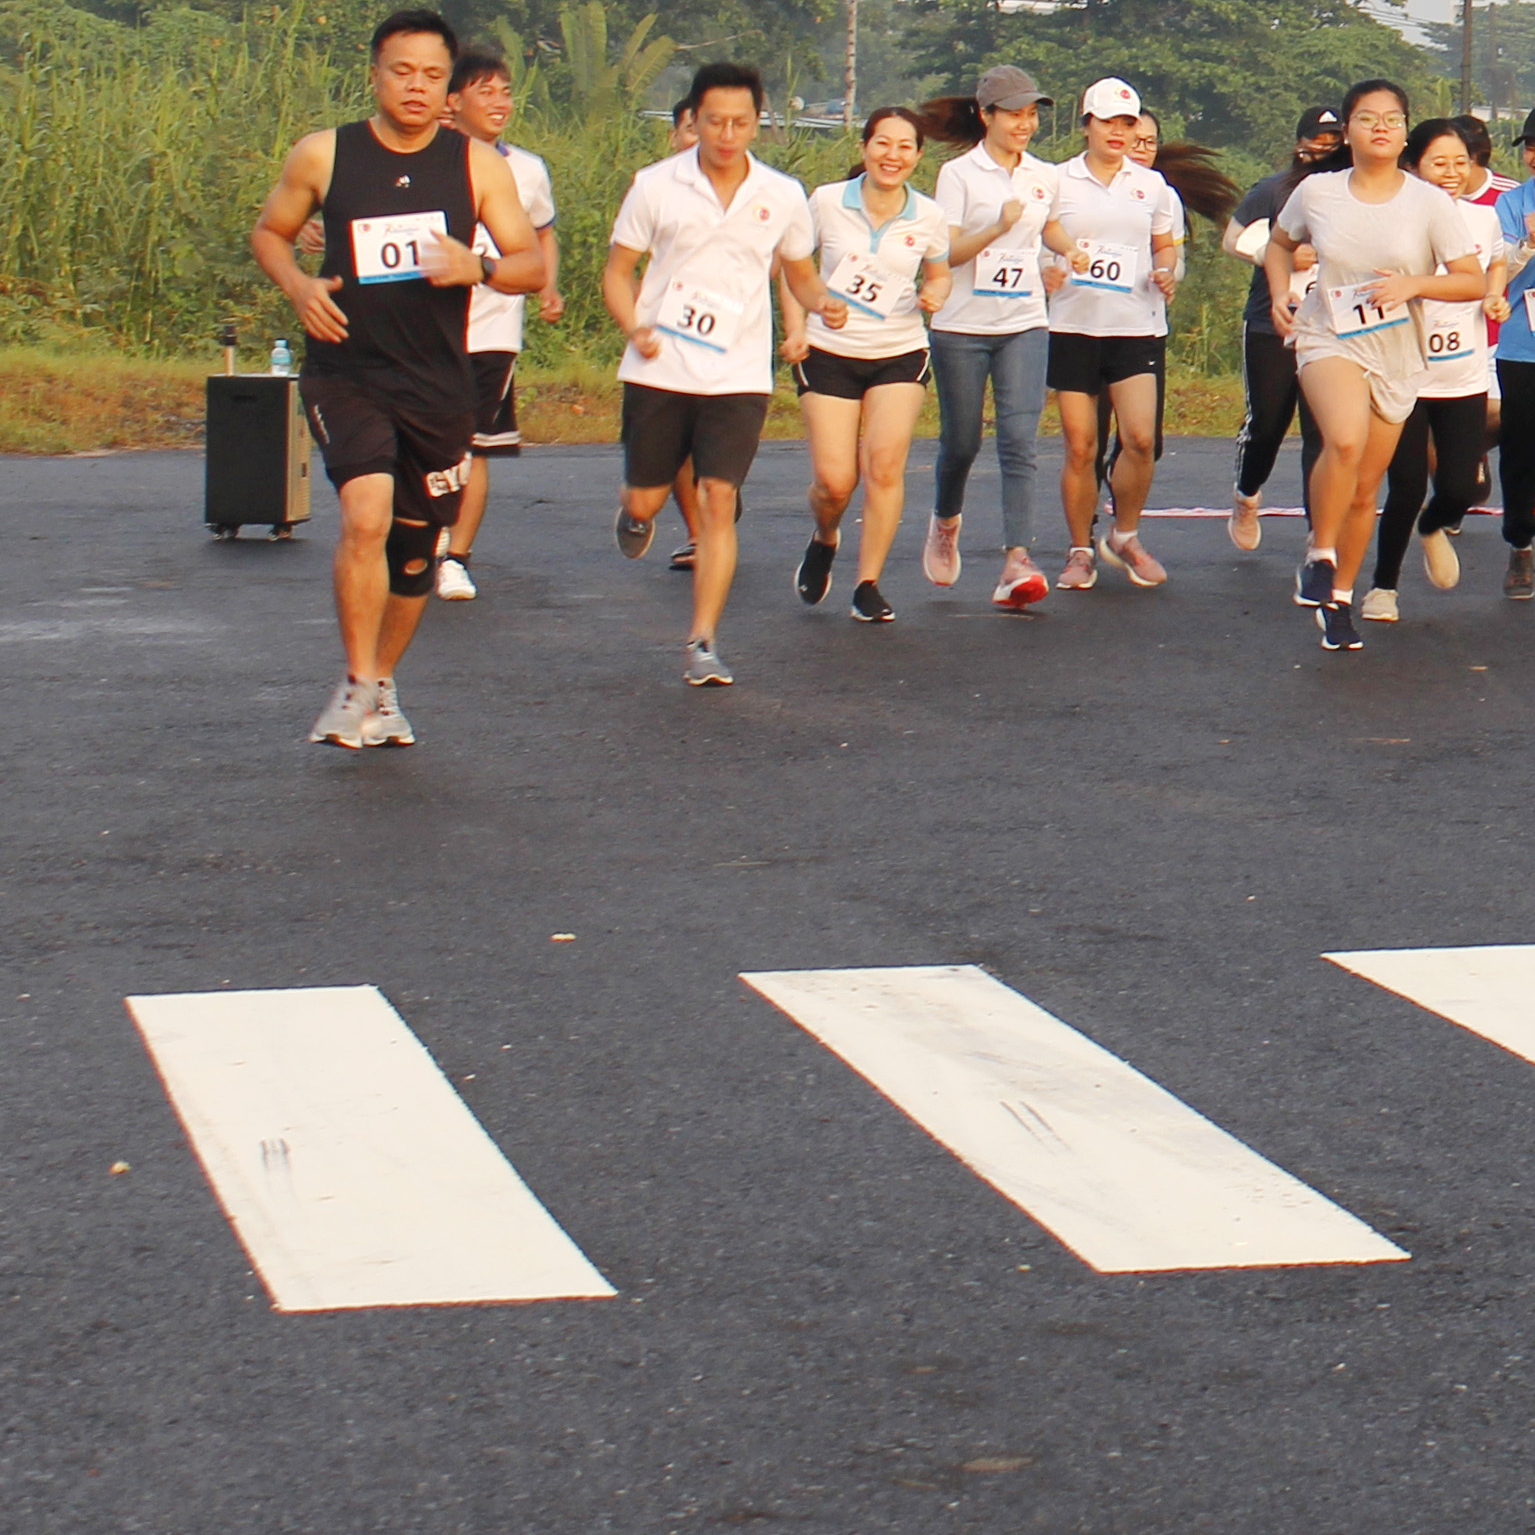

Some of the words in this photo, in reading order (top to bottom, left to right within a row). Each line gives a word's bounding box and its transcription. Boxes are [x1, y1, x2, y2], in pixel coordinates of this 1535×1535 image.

[381, 240, 420, 268] 01
[992, 267, 1024, 288] 47
[1090, 260, 1121, 281] 60
[845, 275, 882, 302] 35
[677, 305, 715, 335] 30
[1353, 304, 1385, 325] 11
[1429, 331, 1461, 353] 08
